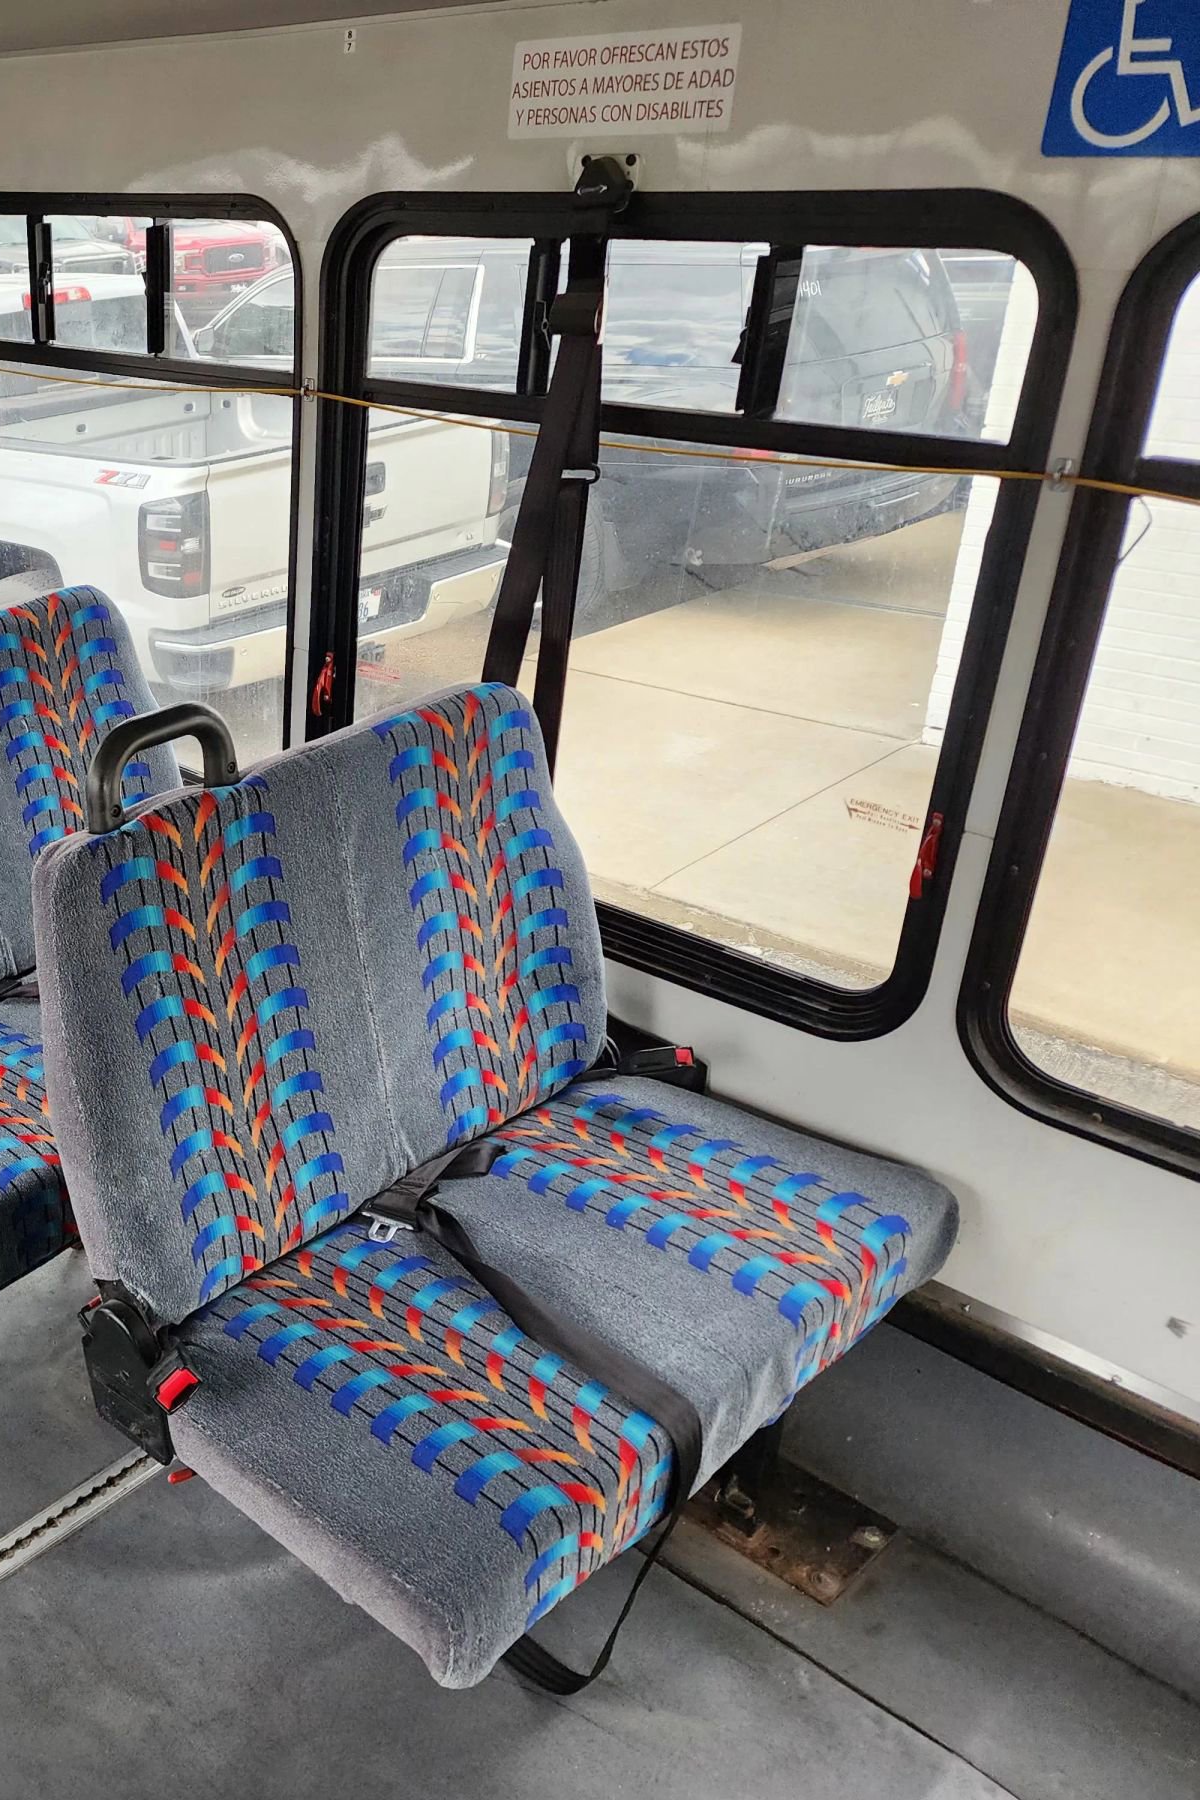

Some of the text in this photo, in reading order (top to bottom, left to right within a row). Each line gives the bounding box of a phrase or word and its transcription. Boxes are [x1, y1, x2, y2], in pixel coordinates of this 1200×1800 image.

[522, 37, 730, 71] POR FAVOR OFRESCAN ESTOS
[512, 68, 735, 100] ASIENTOS A MAYORES DE ADAD
[516, 99, 724, 126] Y PERSONAS CON DISABILITES
[850, 798, 899, 817] EMERGENCY
[902, 813, 920, 824] EXIT
